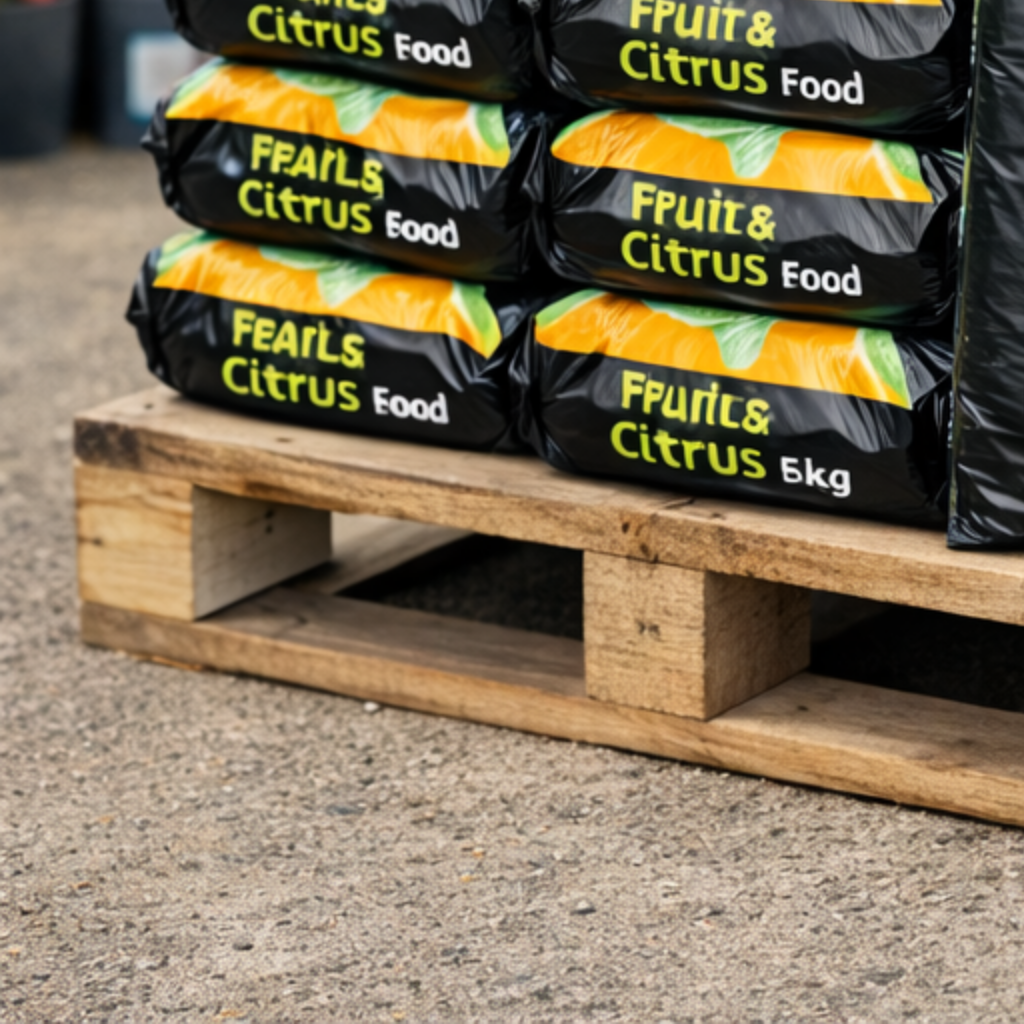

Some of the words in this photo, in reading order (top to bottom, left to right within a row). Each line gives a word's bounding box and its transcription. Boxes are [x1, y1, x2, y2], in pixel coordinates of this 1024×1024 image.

[246, 4, 384, 59] Citrus
[393, 32, 472, 69] Food
[746, 10, 777, 50] &
[619, 39, 769, 96] Citrus
[780, 67, 866, 106] Food
[237, 179, 374, 235] Citrus
[746, 204, 777, 243] &
[620, 230, 769, 287] Citrus
[780, 260, 863, 297] Food
[221, 356, 361, 413] Citrus
[372, 386, 450, 425] Food
[609, 421, 767, 481] Citrus
